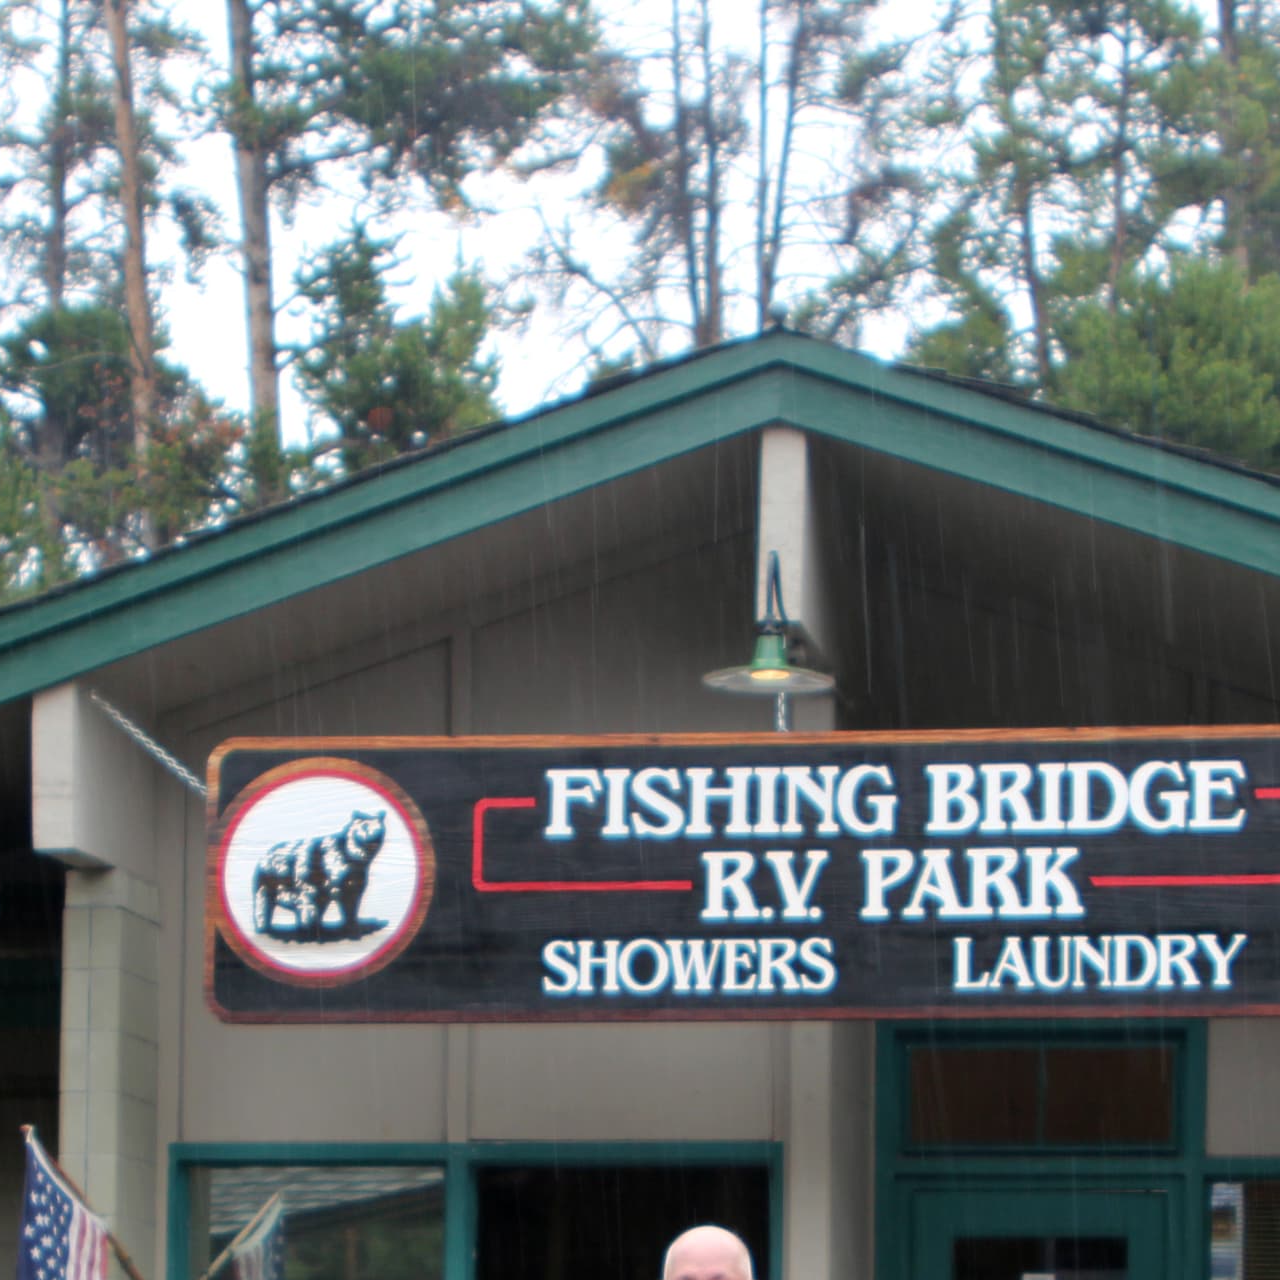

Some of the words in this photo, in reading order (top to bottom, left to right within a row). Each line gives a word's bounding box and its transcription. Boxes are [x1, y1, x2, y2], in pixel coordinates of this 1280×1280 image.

[545, 765, 897, 837] FISHING
[926, 761, 1245, 833] BRIDGE
[702, 850, 828, 920] R.V.
[861, 847, 1084, 918] PARK
[544, 938, 835, 993] SHOWERS
[955, 934, 1245, 990] LAUNDRY
